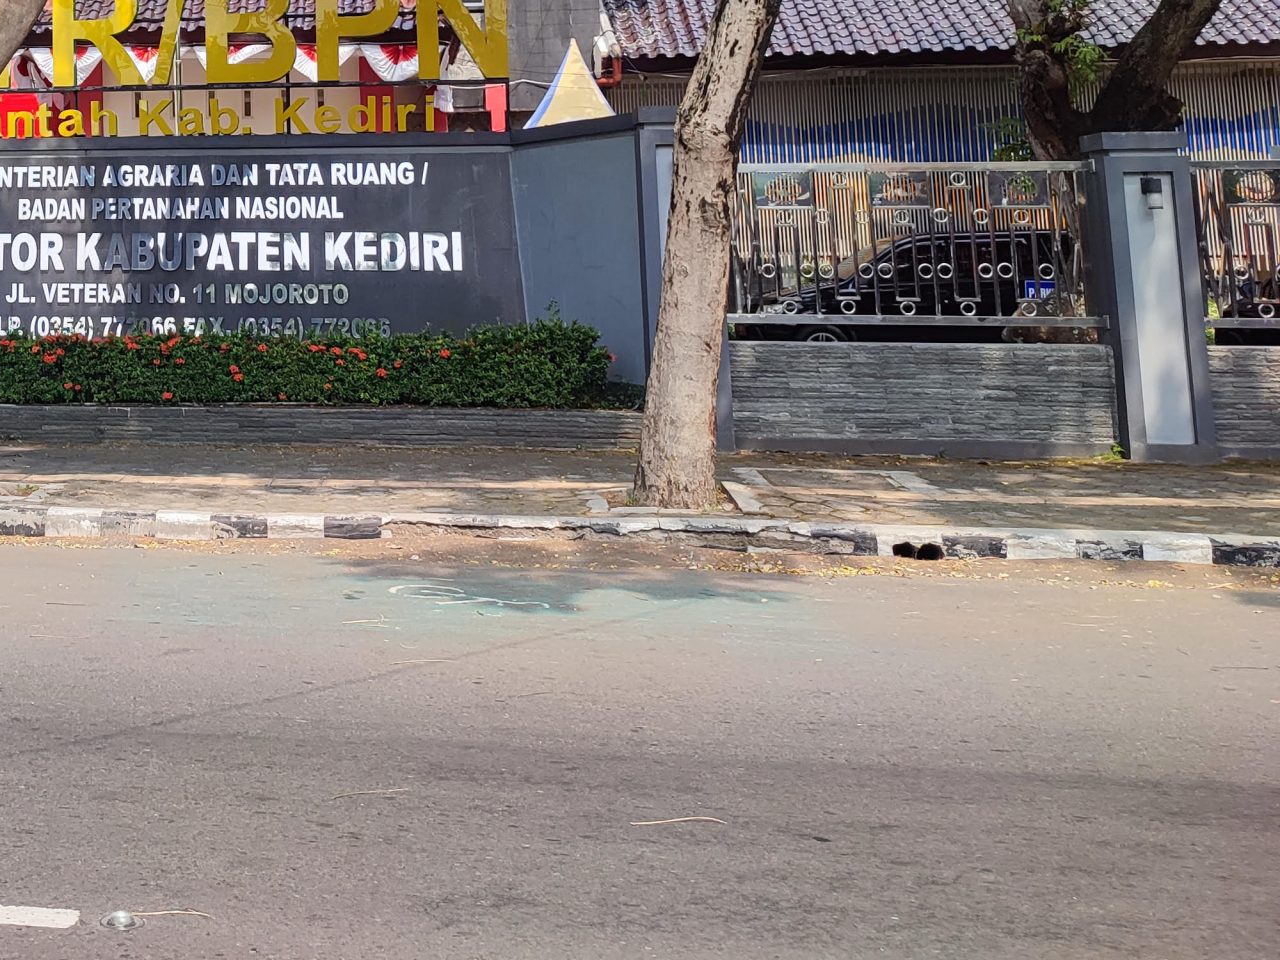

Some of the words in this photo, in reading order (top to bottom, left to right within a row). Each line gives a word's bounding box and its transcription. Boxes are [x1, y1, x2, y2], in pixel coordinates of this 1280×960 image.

[139, 98, 252, 136] Kab.
[274, 94, 436, 135] Kediri
[102, 164, 205, 188] AGRARIA
[211, 163, 258, 187] DAN
[265, 162, 324, 186] TATA
[330, 161, 415, 186] RUANG
[18, 197, 86, 221] BADAN
[91, 196, 230, 220] PERTANAHAN
[235, 196, 344, 219] NASIONAL
[76, 231, 310, 272] KABUPATEN
[324, 231, 463, 272] KEDIRI
[5, 283, 36, 304] JL.
[42, 283, 142, 304] VETERAN
[149, 283, 186, 304] NO.
[193, 284, 216, 304] 11
[225, 283, 350, 305] MOJOROTO
[30, 315, 94, 341] (0354)
